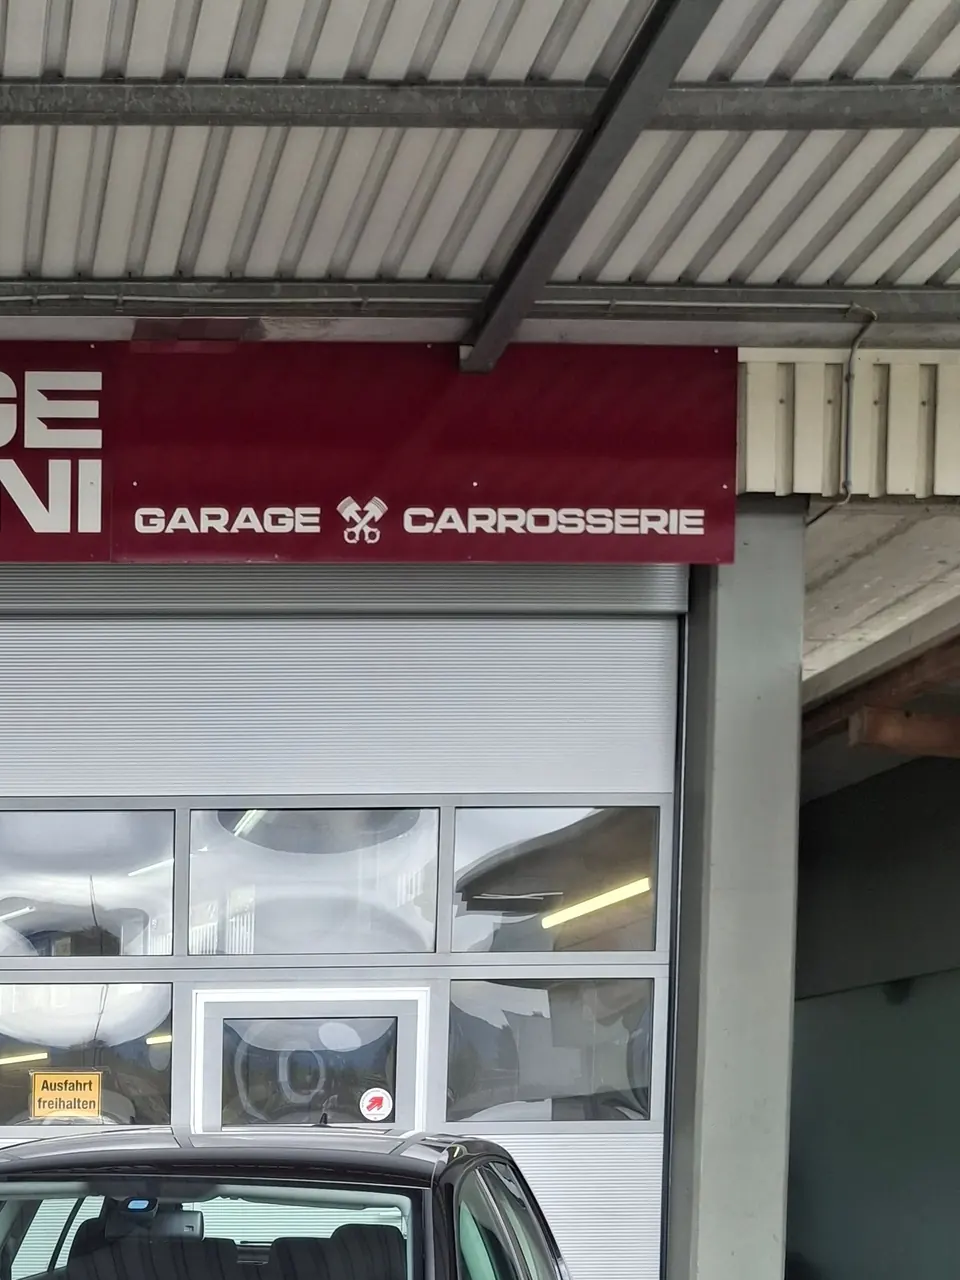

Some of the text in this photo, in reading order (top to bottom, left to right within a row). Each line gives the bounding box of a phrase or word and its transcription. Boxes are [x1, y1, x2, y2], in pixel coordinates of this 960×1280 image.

[134, 506, 705, 536] GARAGE CARROSSERIE
[40, 1079, 93, 1092] Ausfahrt
[37, 1097, 96, 1110] freihalten
